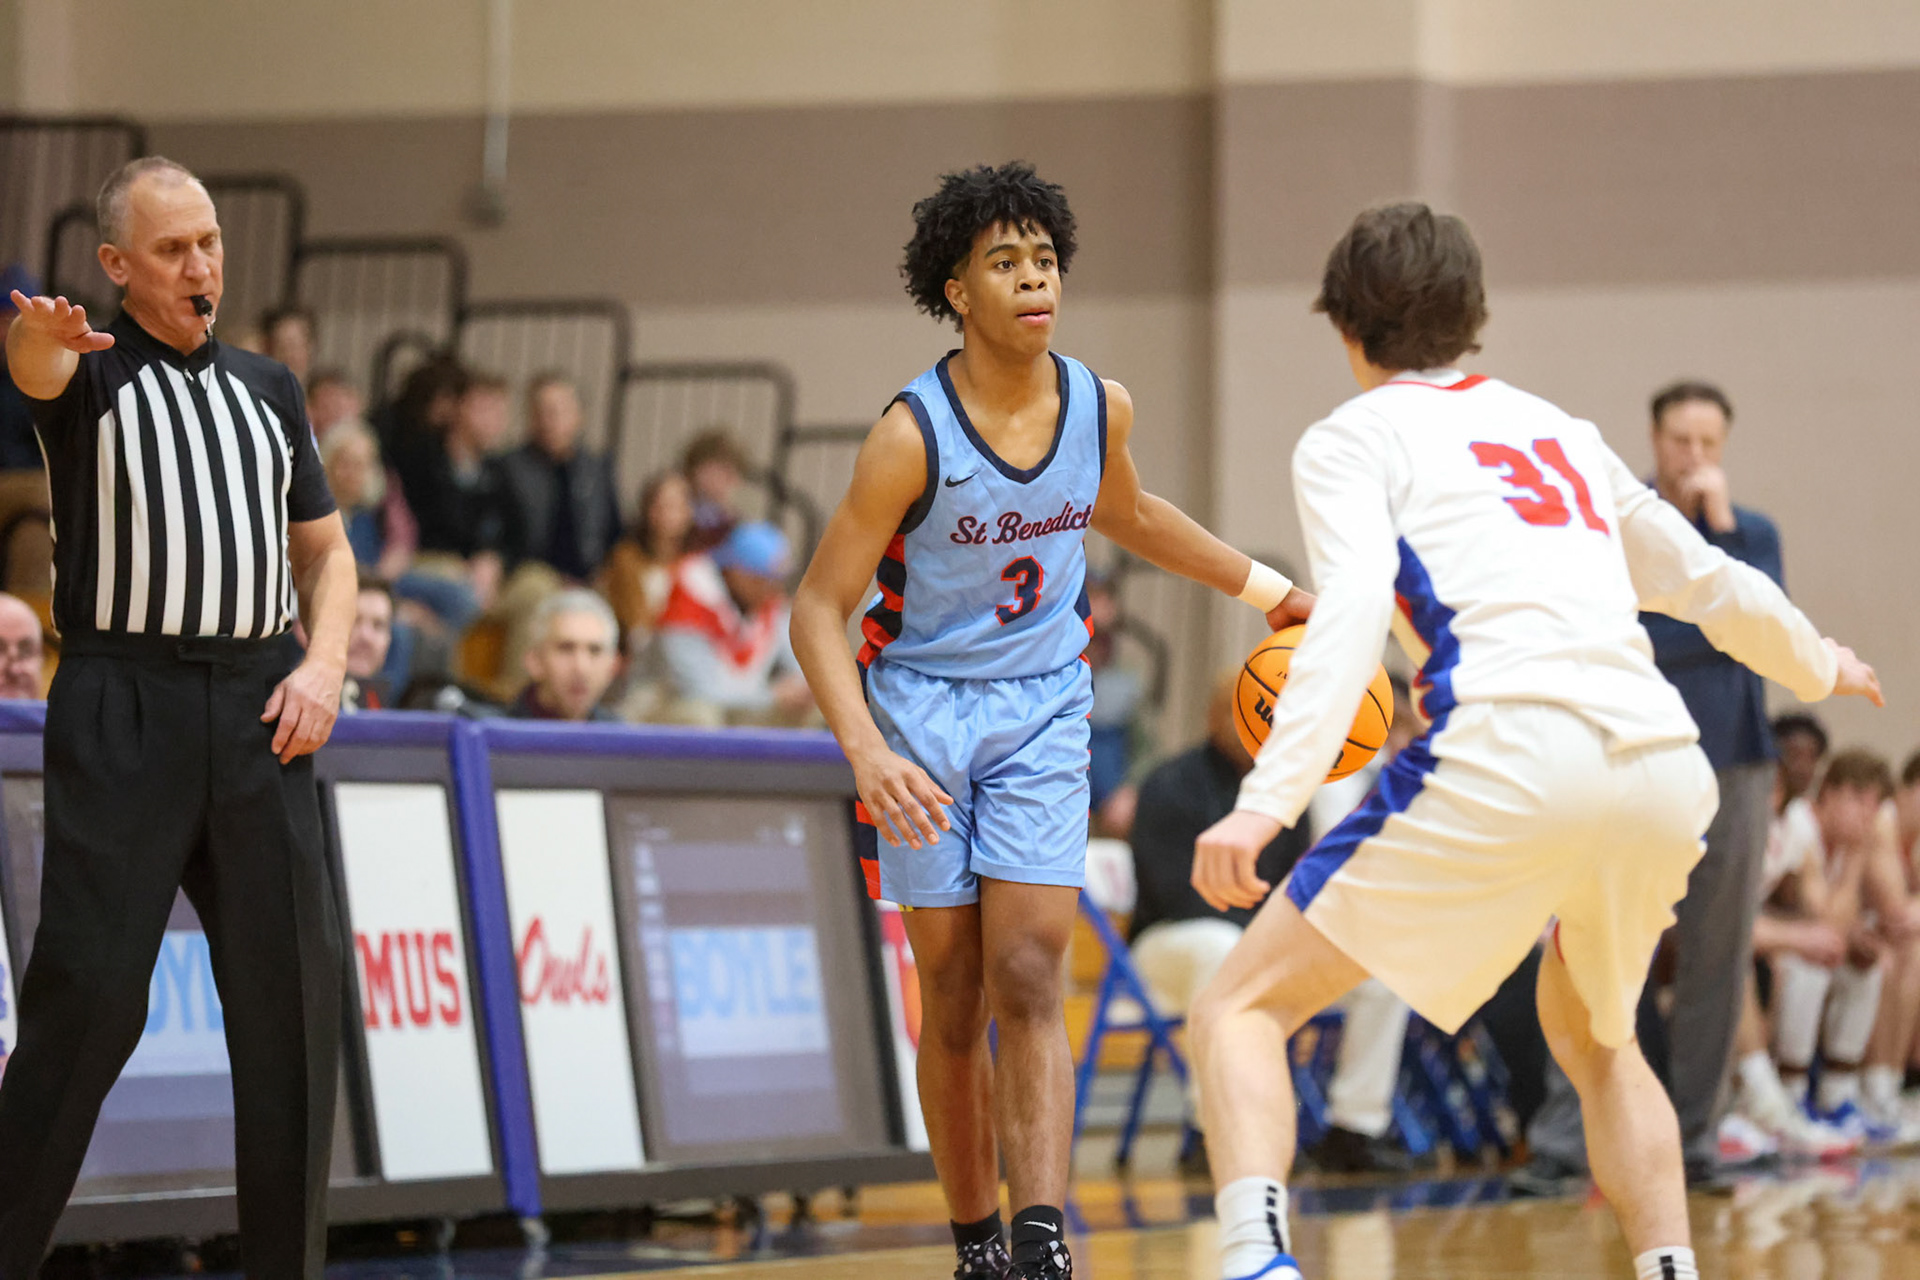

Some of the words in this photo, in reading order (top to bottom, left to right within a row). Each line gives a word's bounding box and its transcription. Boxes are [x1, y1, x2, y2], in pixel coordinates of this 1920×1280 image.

[950, 516, 988, 545] St
[992, 501, 1093, 545] Benedict
[1468, 438, 1611, 539] 31
[994, 555, 1045, 627] 3
[352, 931, 462, 1029] MUS
[515, 916, 611, 1004] Owls
